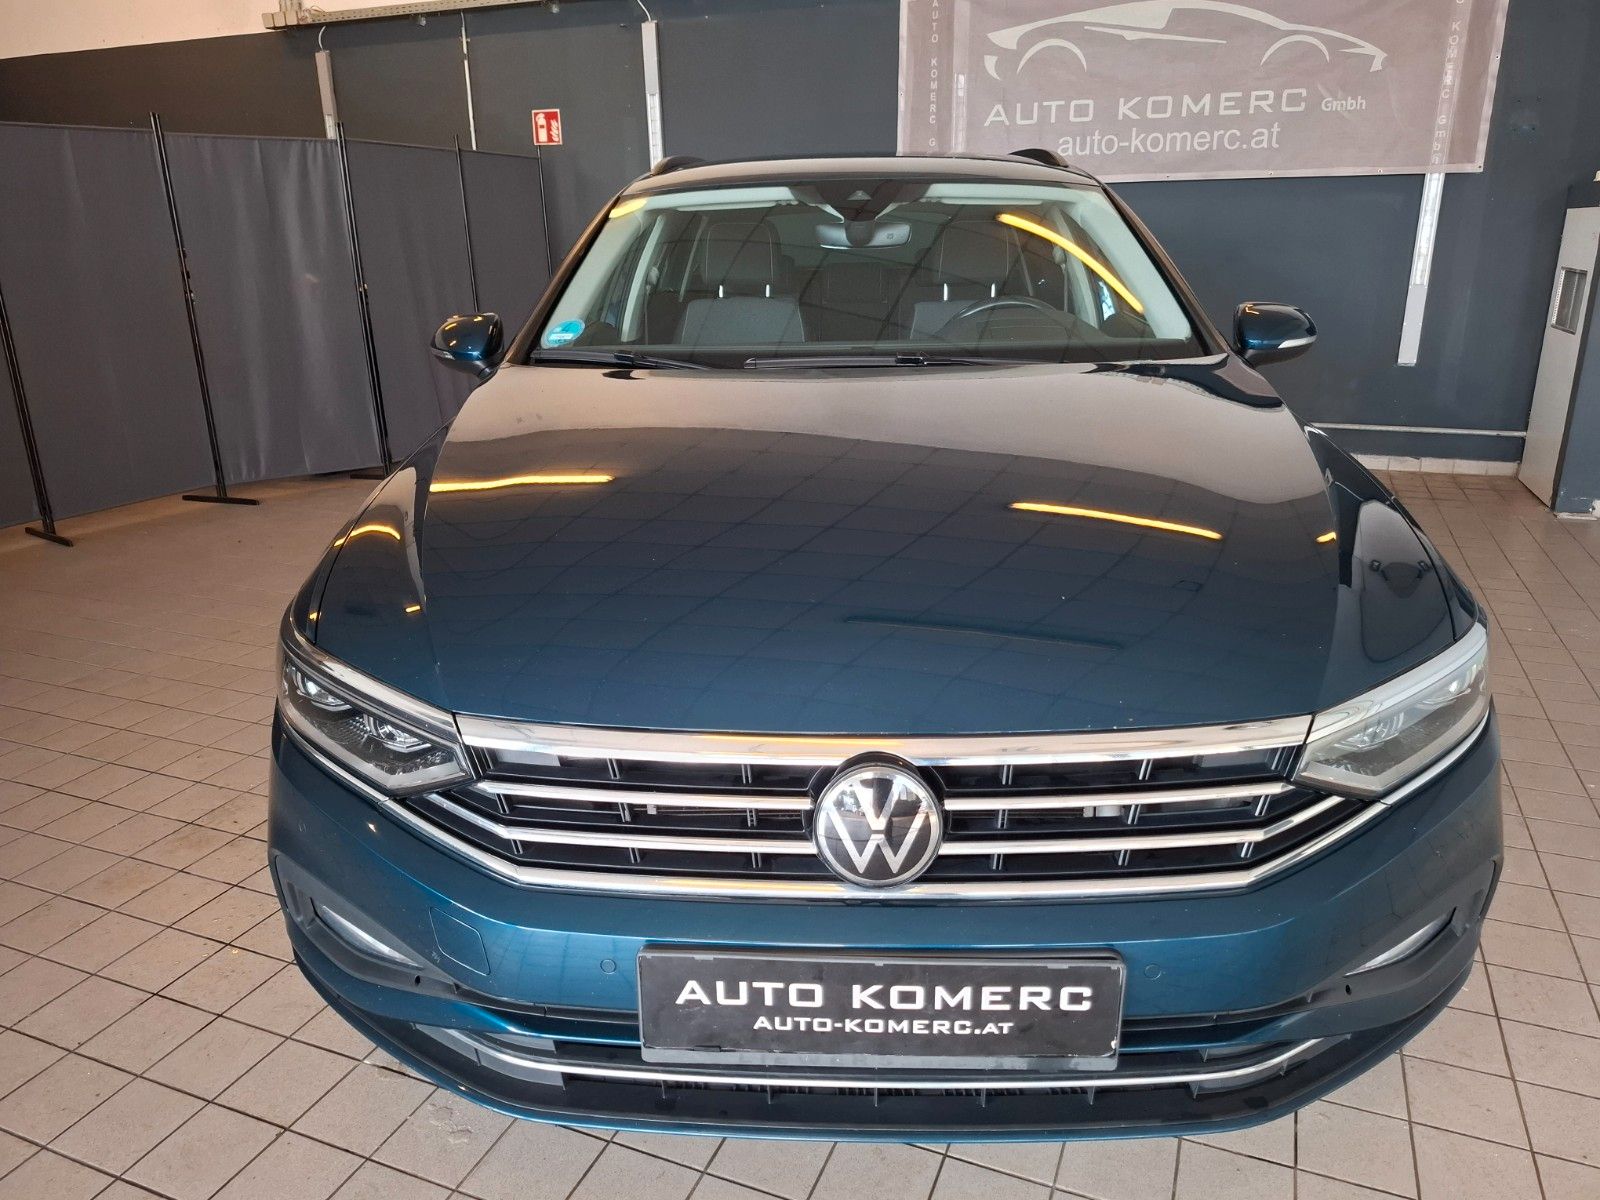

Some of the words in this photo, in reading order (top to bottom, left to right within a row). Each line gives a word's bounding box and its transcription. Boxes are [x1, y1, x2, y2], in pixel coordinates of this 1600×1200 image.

[931, 0, 939, 43] AUTO
[929, 57, 938, 124] KOMERC
[983, 99, 1095, 127] AUTO
[1117, 88, 1307, 120] KOMERC
[1321, 95, 1367, 112] Gmbh
[1058, 121, 1281, 157] auto-komerc.at
[675, 979, 824, 1008] AUTO
[851, 984, 1093, 1012] KOMERC
[752, 1015, 1014, 1035] AUTO-KOMERC.AT
